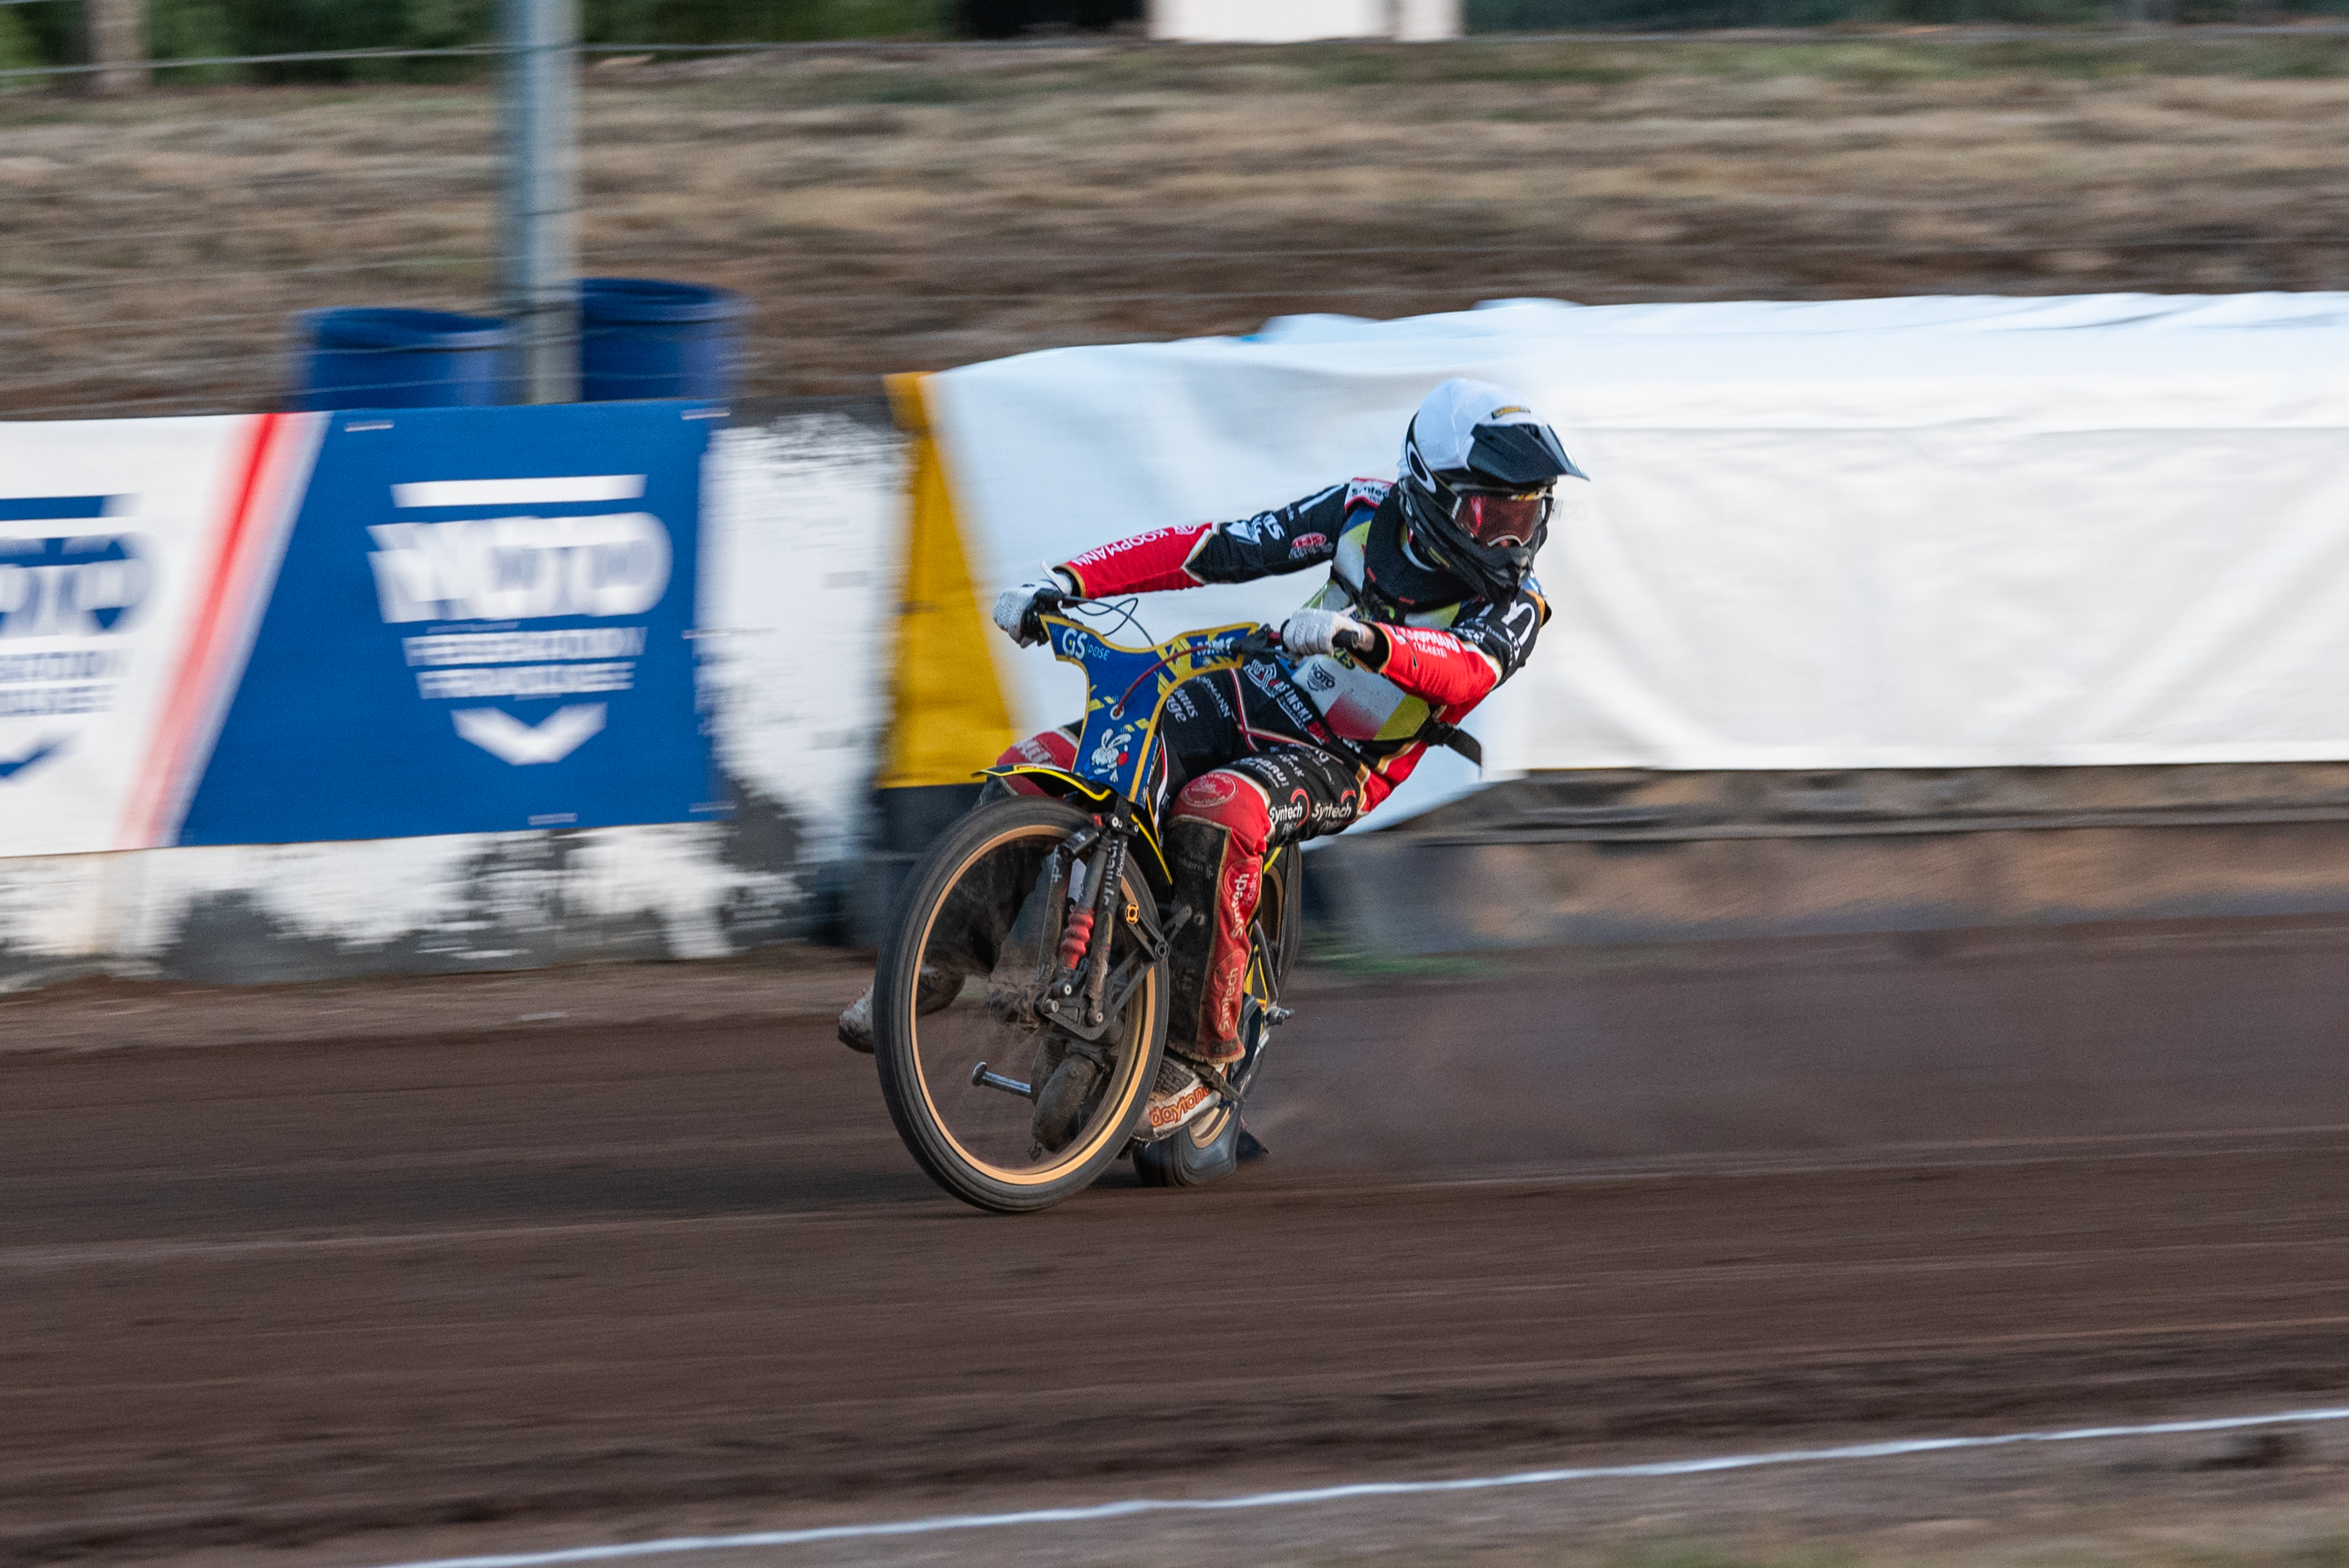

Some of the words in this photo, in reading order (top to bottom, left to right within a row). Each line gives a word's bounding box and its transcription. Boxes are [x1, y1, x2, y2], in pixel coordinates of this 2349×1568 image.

[1062, 627, 1088, 660] GS
[1269, 801, 1303, 825] Syntech
[1312, 802, 1352, 822] Syntech
[1230, 873, 1250, 941] Syntech
